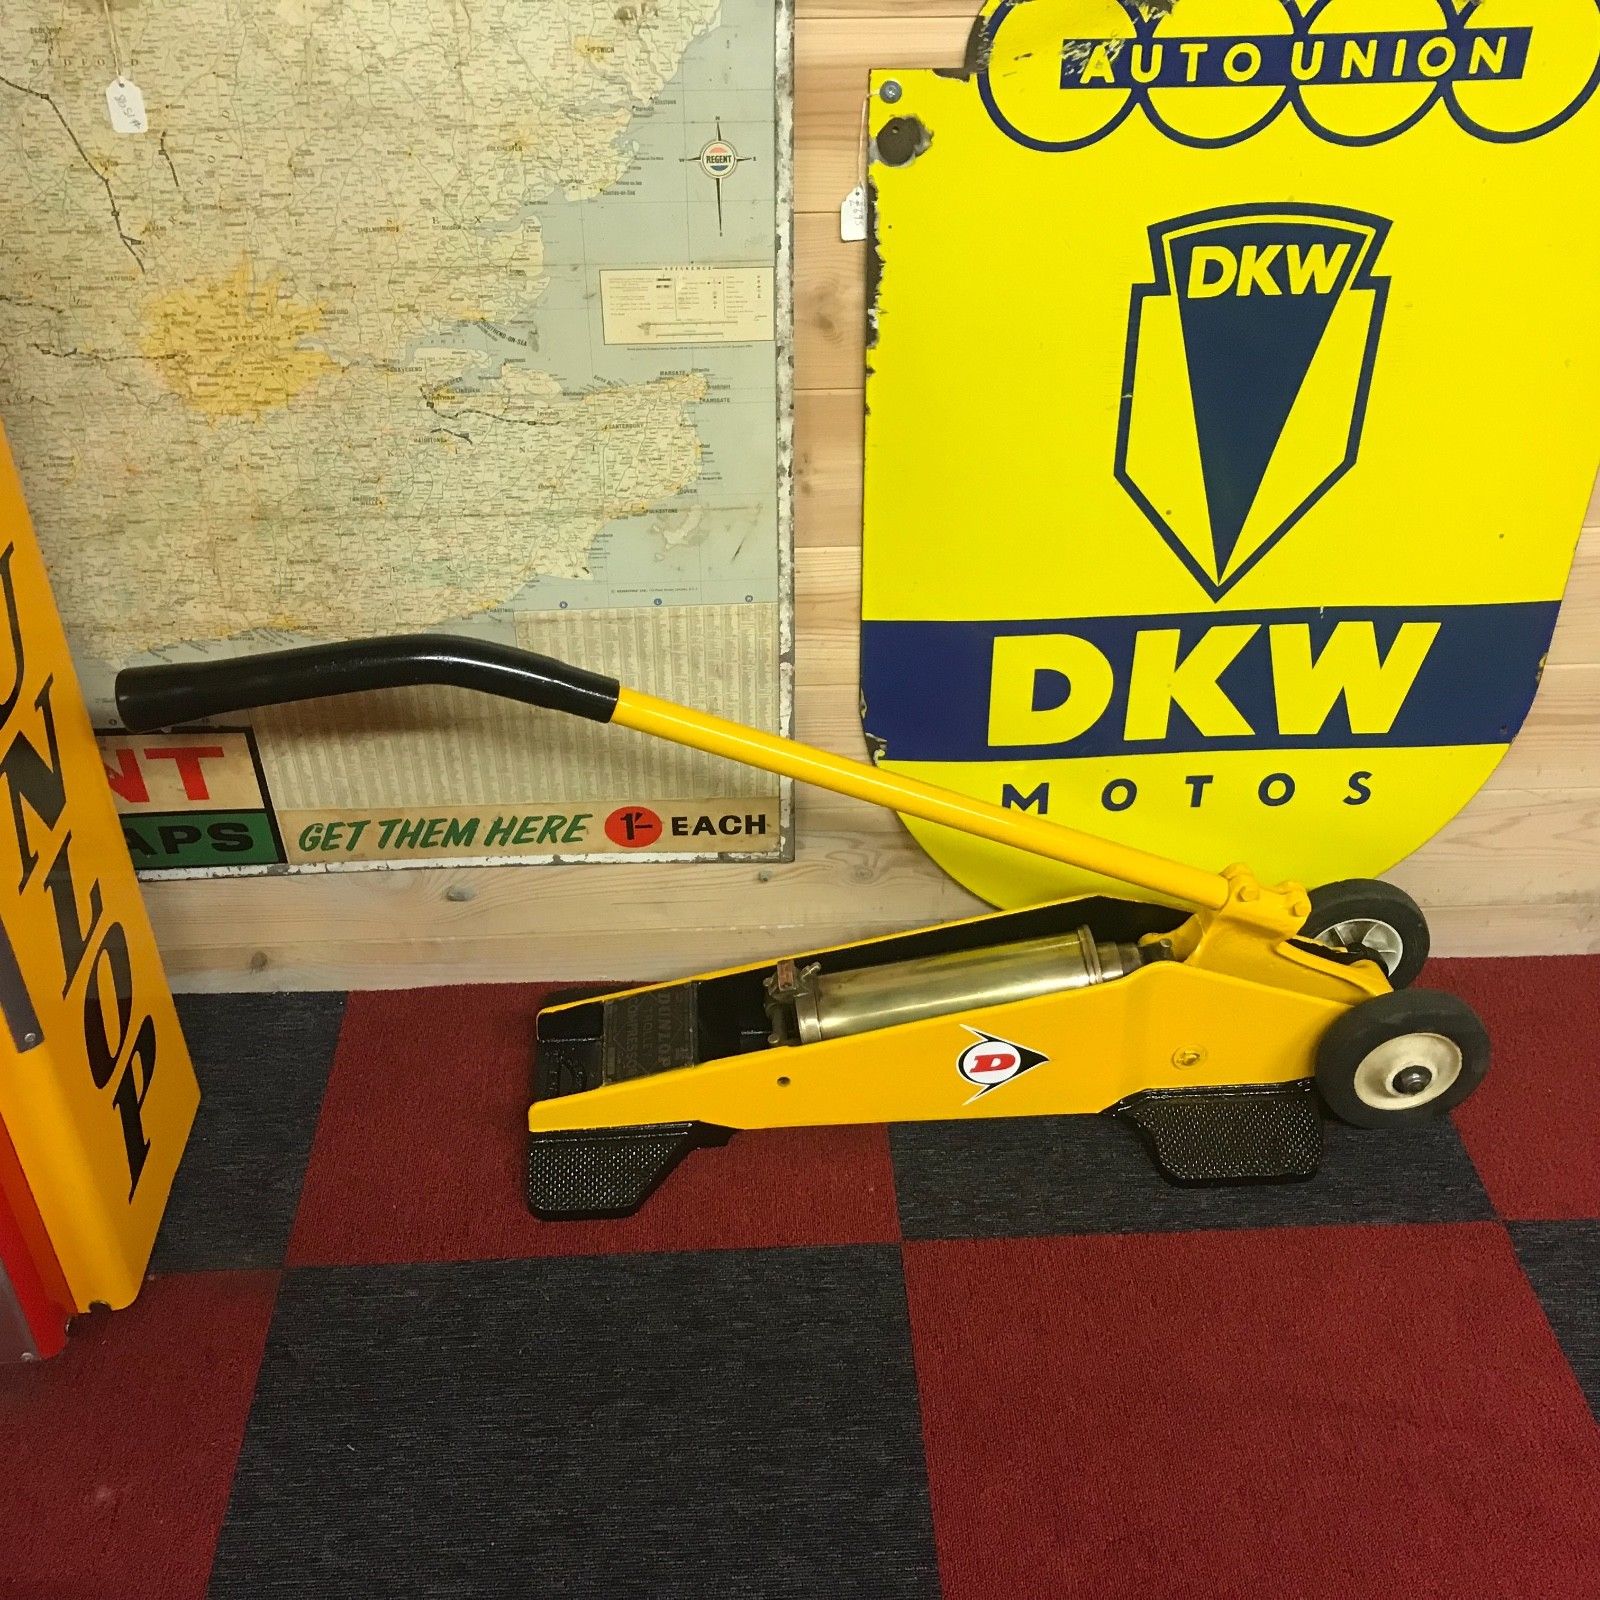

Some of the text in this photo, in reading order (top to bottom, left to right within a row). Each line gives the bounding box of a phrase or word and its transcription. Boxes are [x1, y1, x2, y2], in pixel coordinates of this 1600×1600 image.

[1079, 36, 1511, 84] AUTO UNION
[706, 155, 732, 164] REGENT
[1187, 244, 1351, 299] DKW
[987, 621, 1441, 747] DKW
[1001, 771, 1374, 815] MOTOS
[299, 819, 372, 852] GET
[377, 817, 481, 850] THEM
[484, 813, 594, 847] HERE
[671, 814, 767, 837] EACH
[969, 1053, 1016, 1073] D
